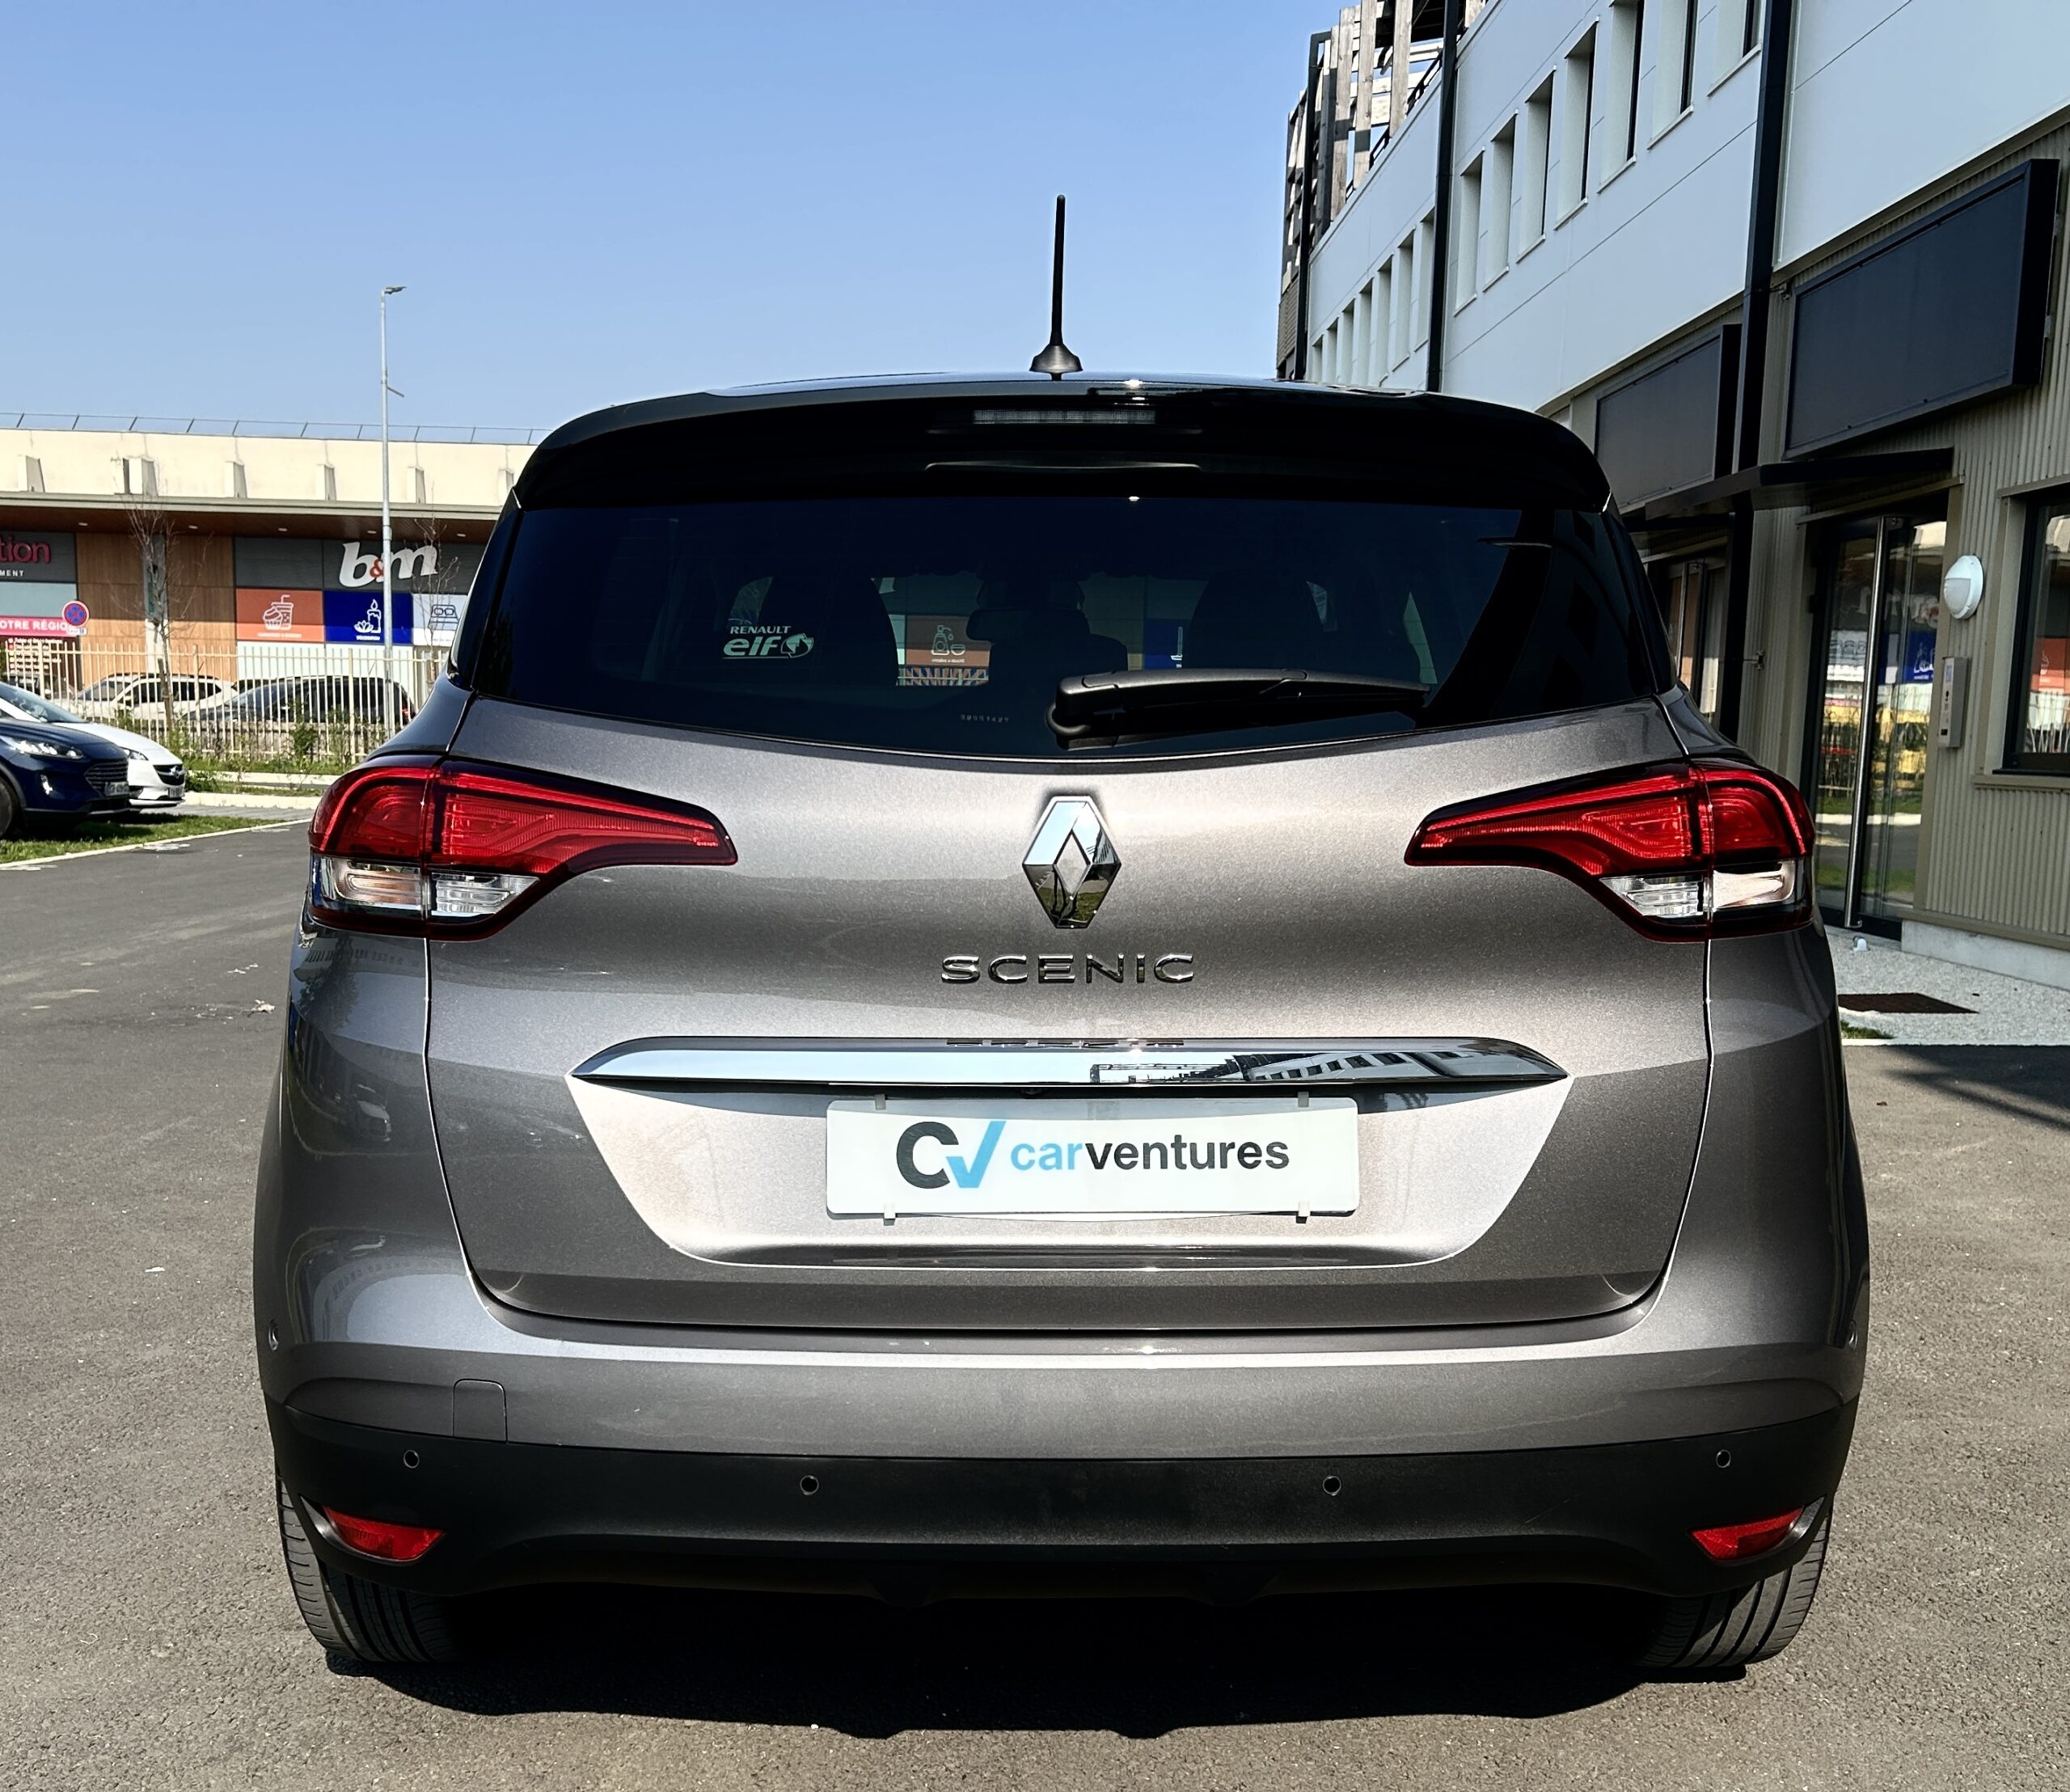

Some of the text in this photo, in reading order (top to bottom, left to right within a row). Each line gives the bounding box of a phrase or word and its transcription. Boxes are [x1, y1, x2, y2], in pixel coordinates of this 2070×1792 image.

[32, 619, 70, 631] RÉGIO
[730, 625, 792, 635] RENAULT
[723, 635, 782, 656] elf
[940, 953, 1194, 984] SCENIC
[1010, 1135, 1290, 1171] carventures
